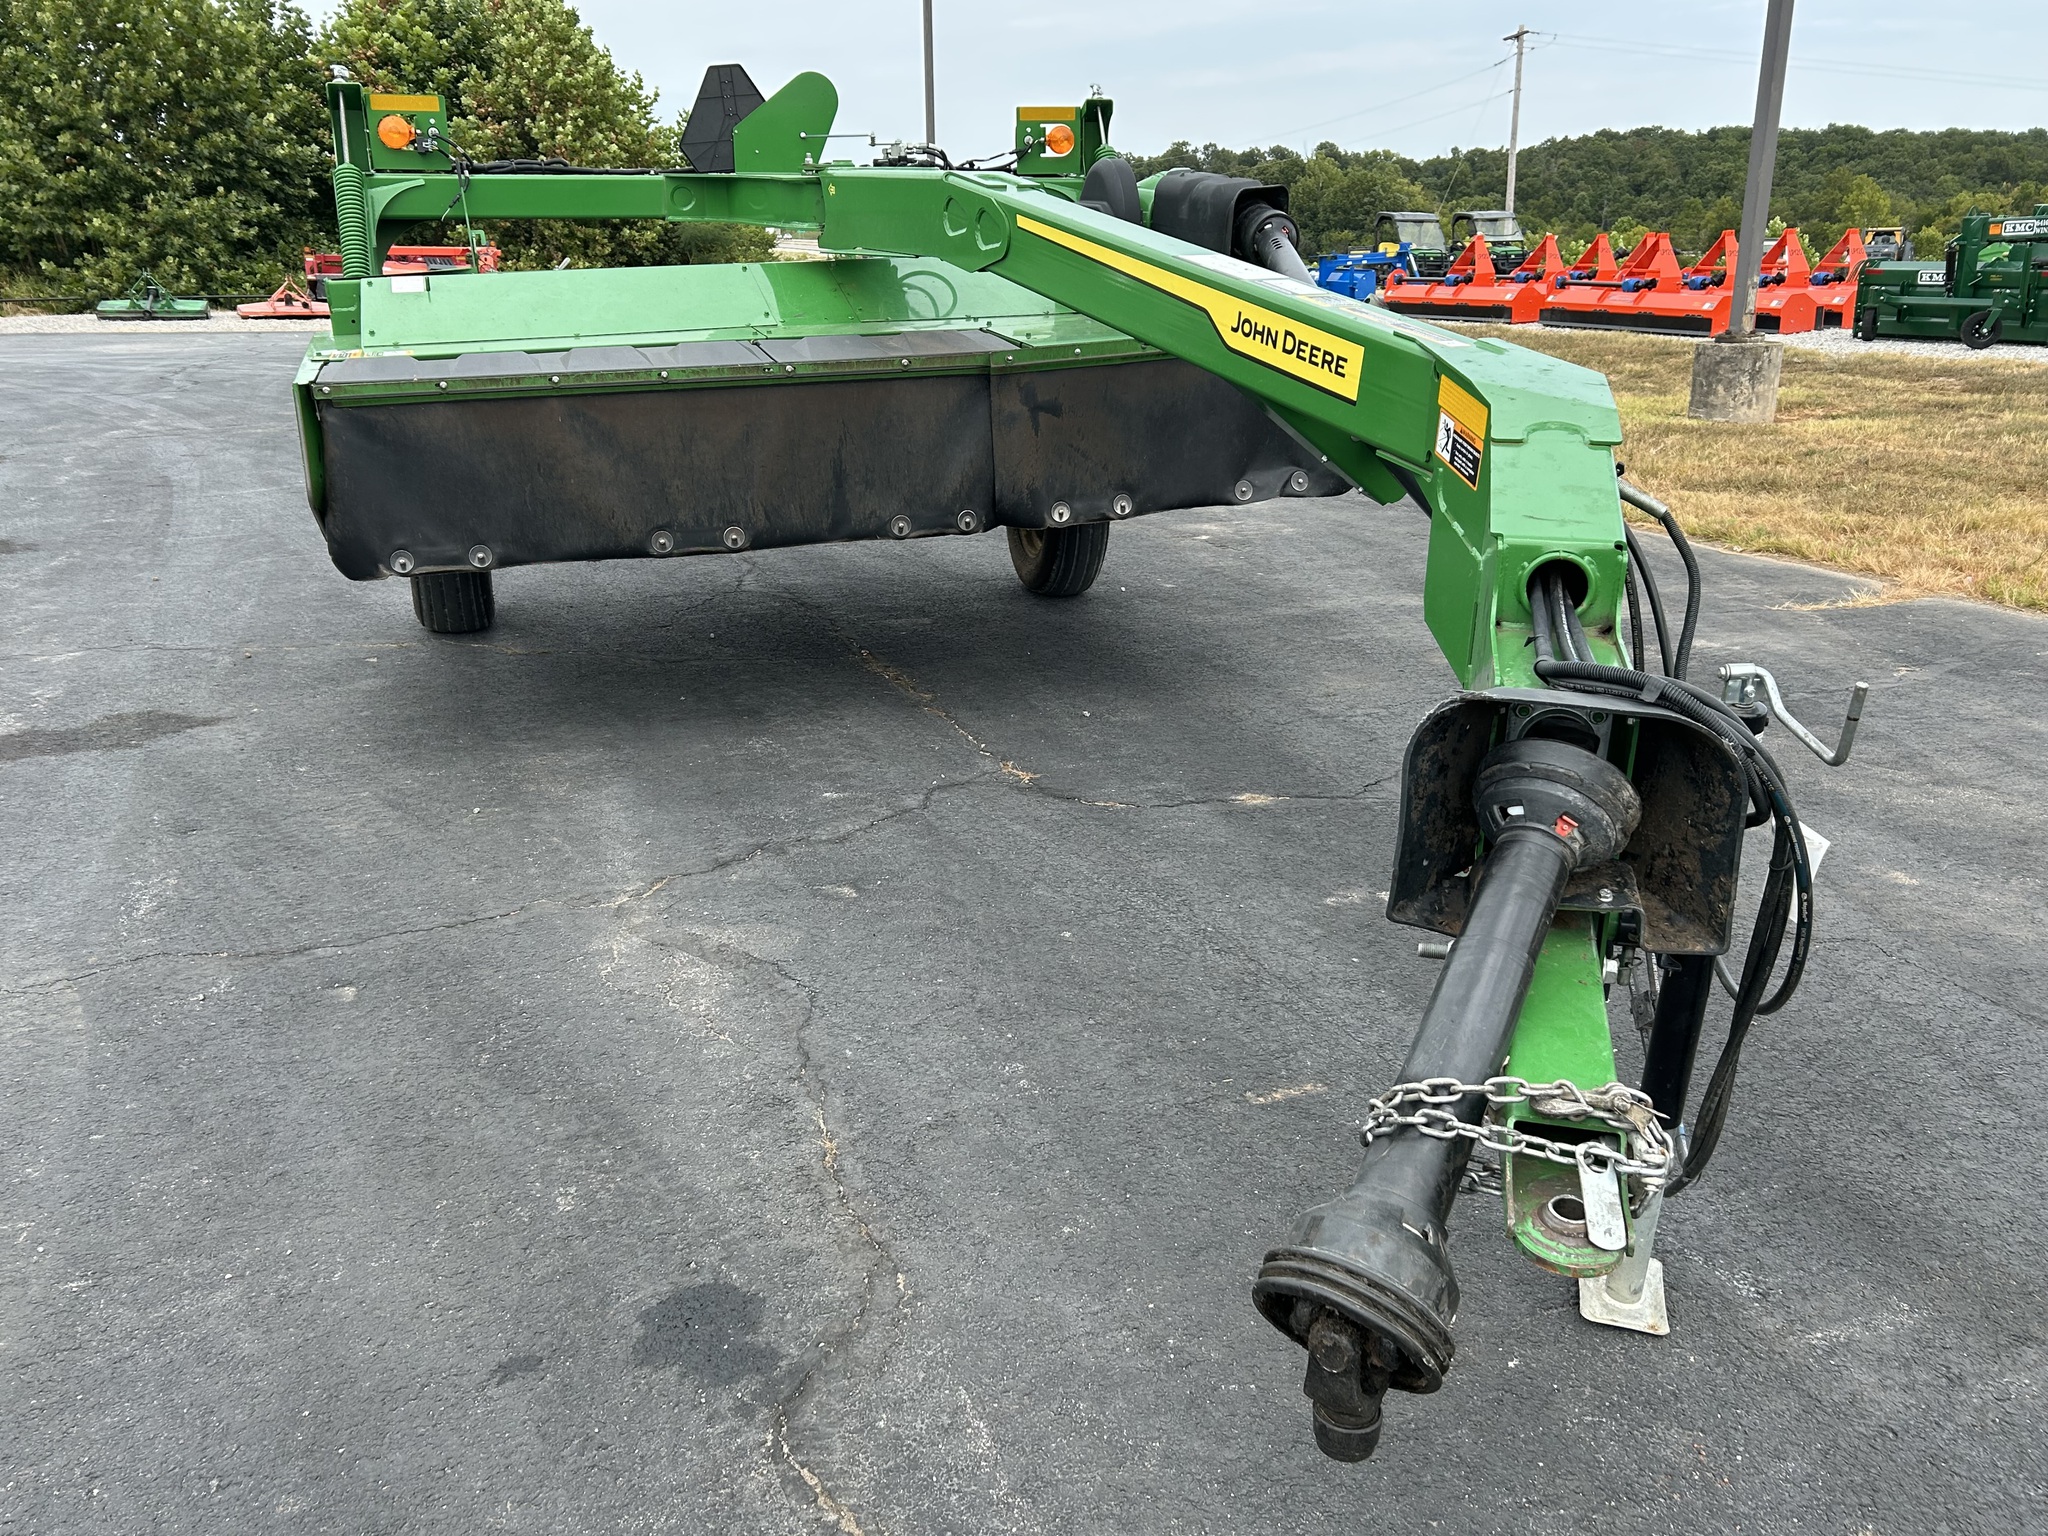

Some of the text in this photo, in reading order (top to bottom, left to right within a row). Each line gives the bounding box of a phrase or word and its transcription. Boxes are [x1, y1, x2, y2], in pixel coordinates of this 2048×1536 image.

[2005, 223, 2033, 232] KMC
[1921, 273, 1946, 281] KM
[1231, 311, 1348, 378] JOHN DEERE
